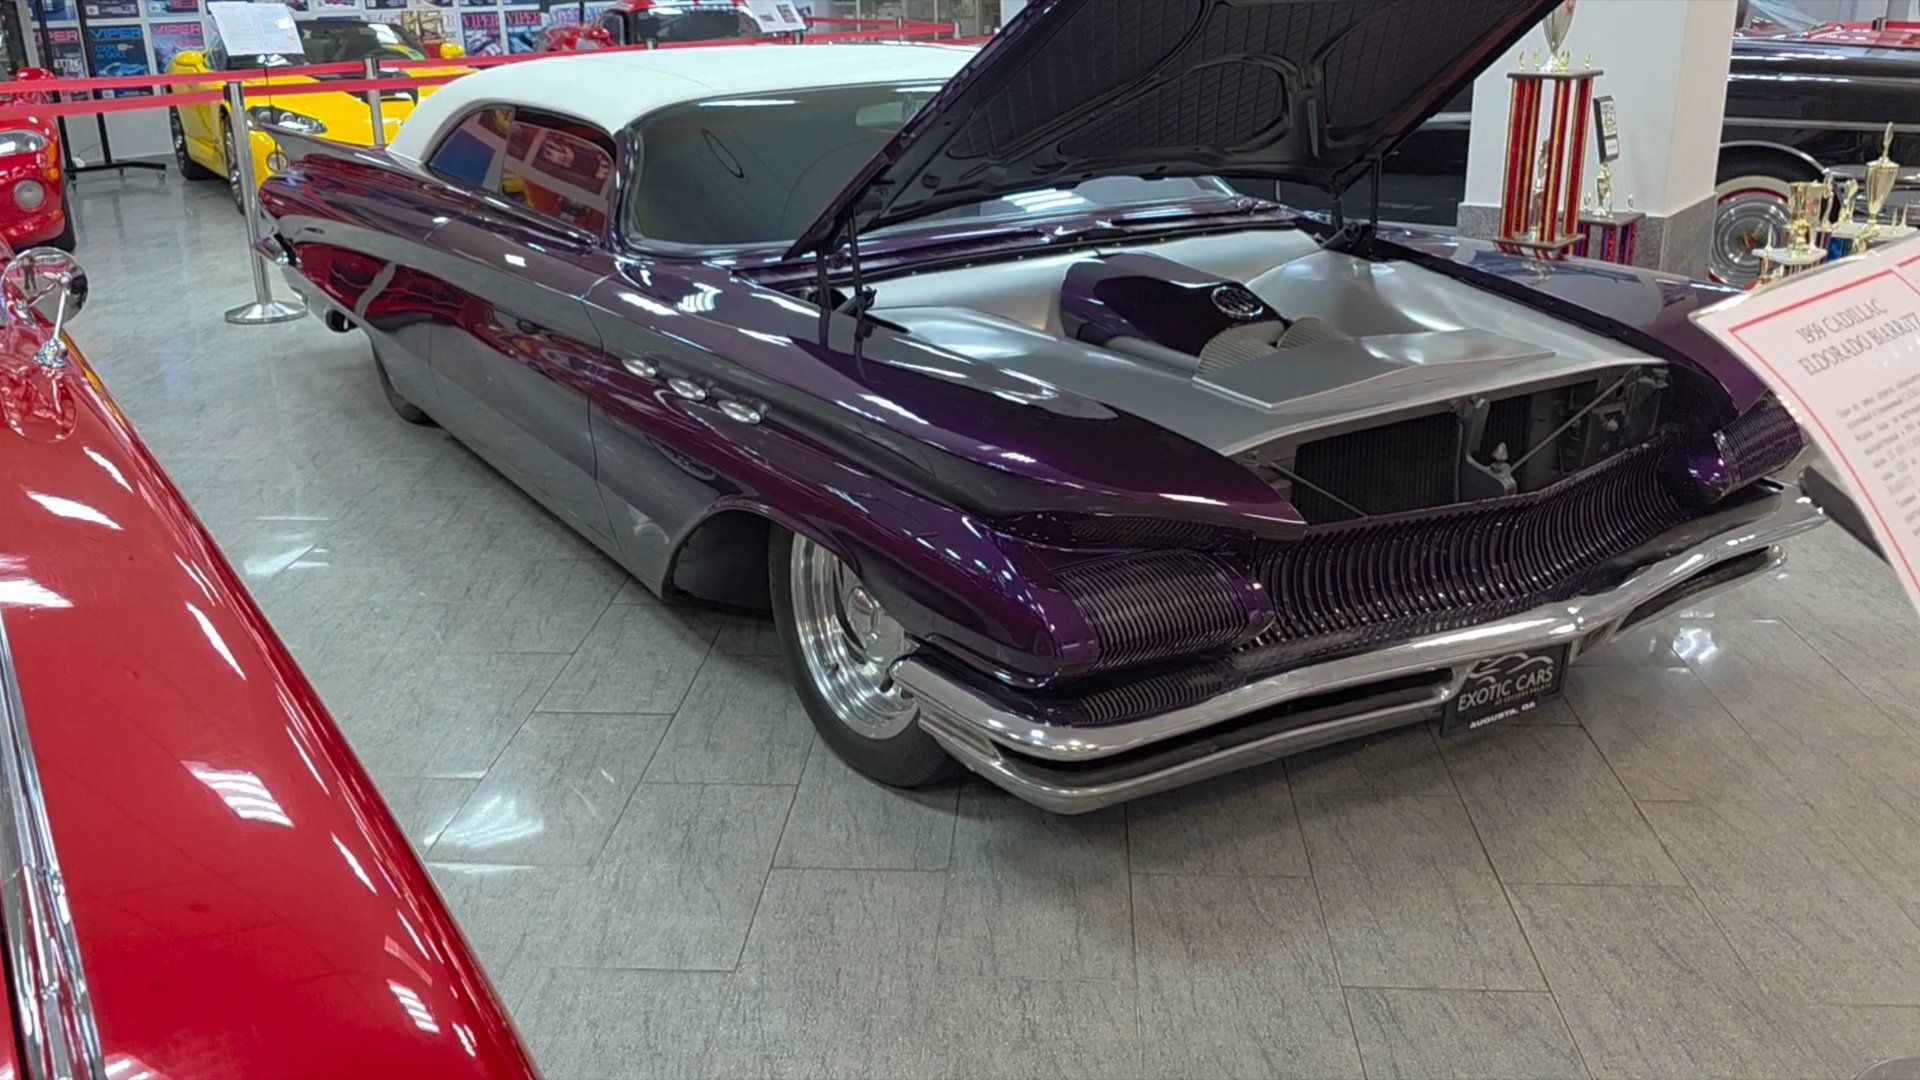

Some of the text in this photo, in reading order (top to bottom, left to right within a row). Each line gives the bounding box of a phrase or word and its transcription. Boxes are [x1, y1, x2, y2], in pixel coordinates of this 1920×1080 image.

[462, 14, 498, 27] VIPER
[505, 12, 541, 25] VIPER
[90, 27, 142, 39] VIPER
[151, 24, 201, 36] VIPER
[1795, 298, 1888, 344] 1959 CADILLAC
[1797, 312, 1920, 376] ELDORADO BIARRITZ
[1457, 679, 1512, 712] EXOTIC
[1515, 666, 1554, 690] CARS
[1469, 701, 1536, 730] AUGUSTA, GA
